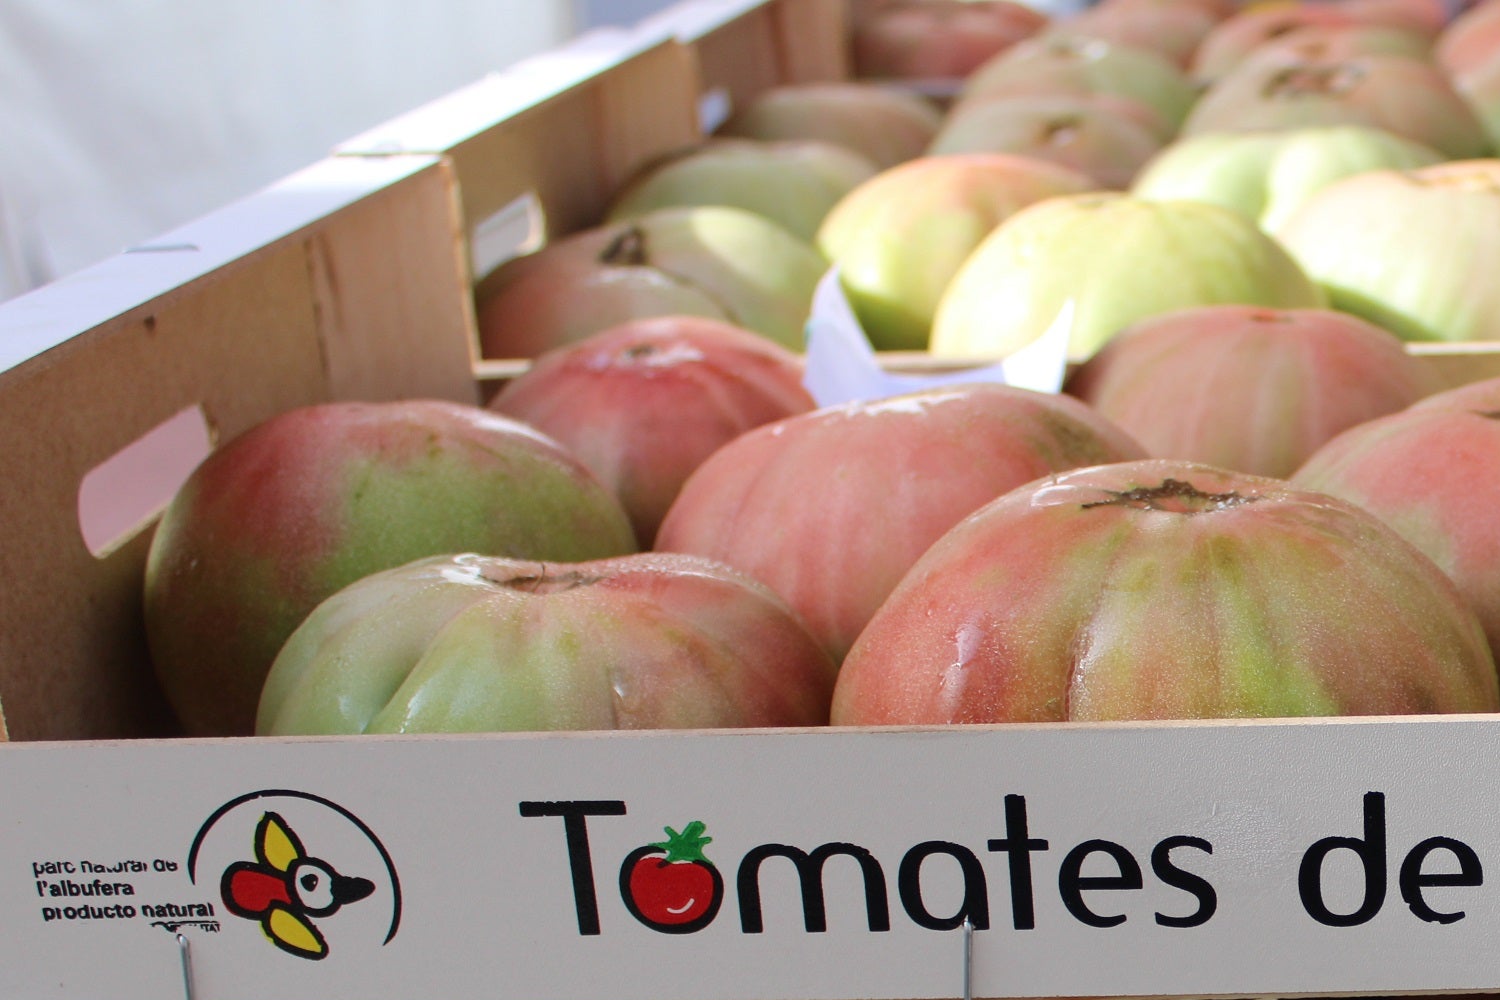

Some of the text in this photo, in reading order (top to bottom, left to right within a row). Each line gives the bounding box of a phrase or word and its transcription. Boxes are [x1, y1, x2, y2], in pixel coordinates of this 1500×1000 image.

[519, 793, 1217, 936] Tomates
[1298, 791, 1484, 926] de
[36, 879, 135, 897] l'albufera
[42, 902, 215, 921] producto natural
